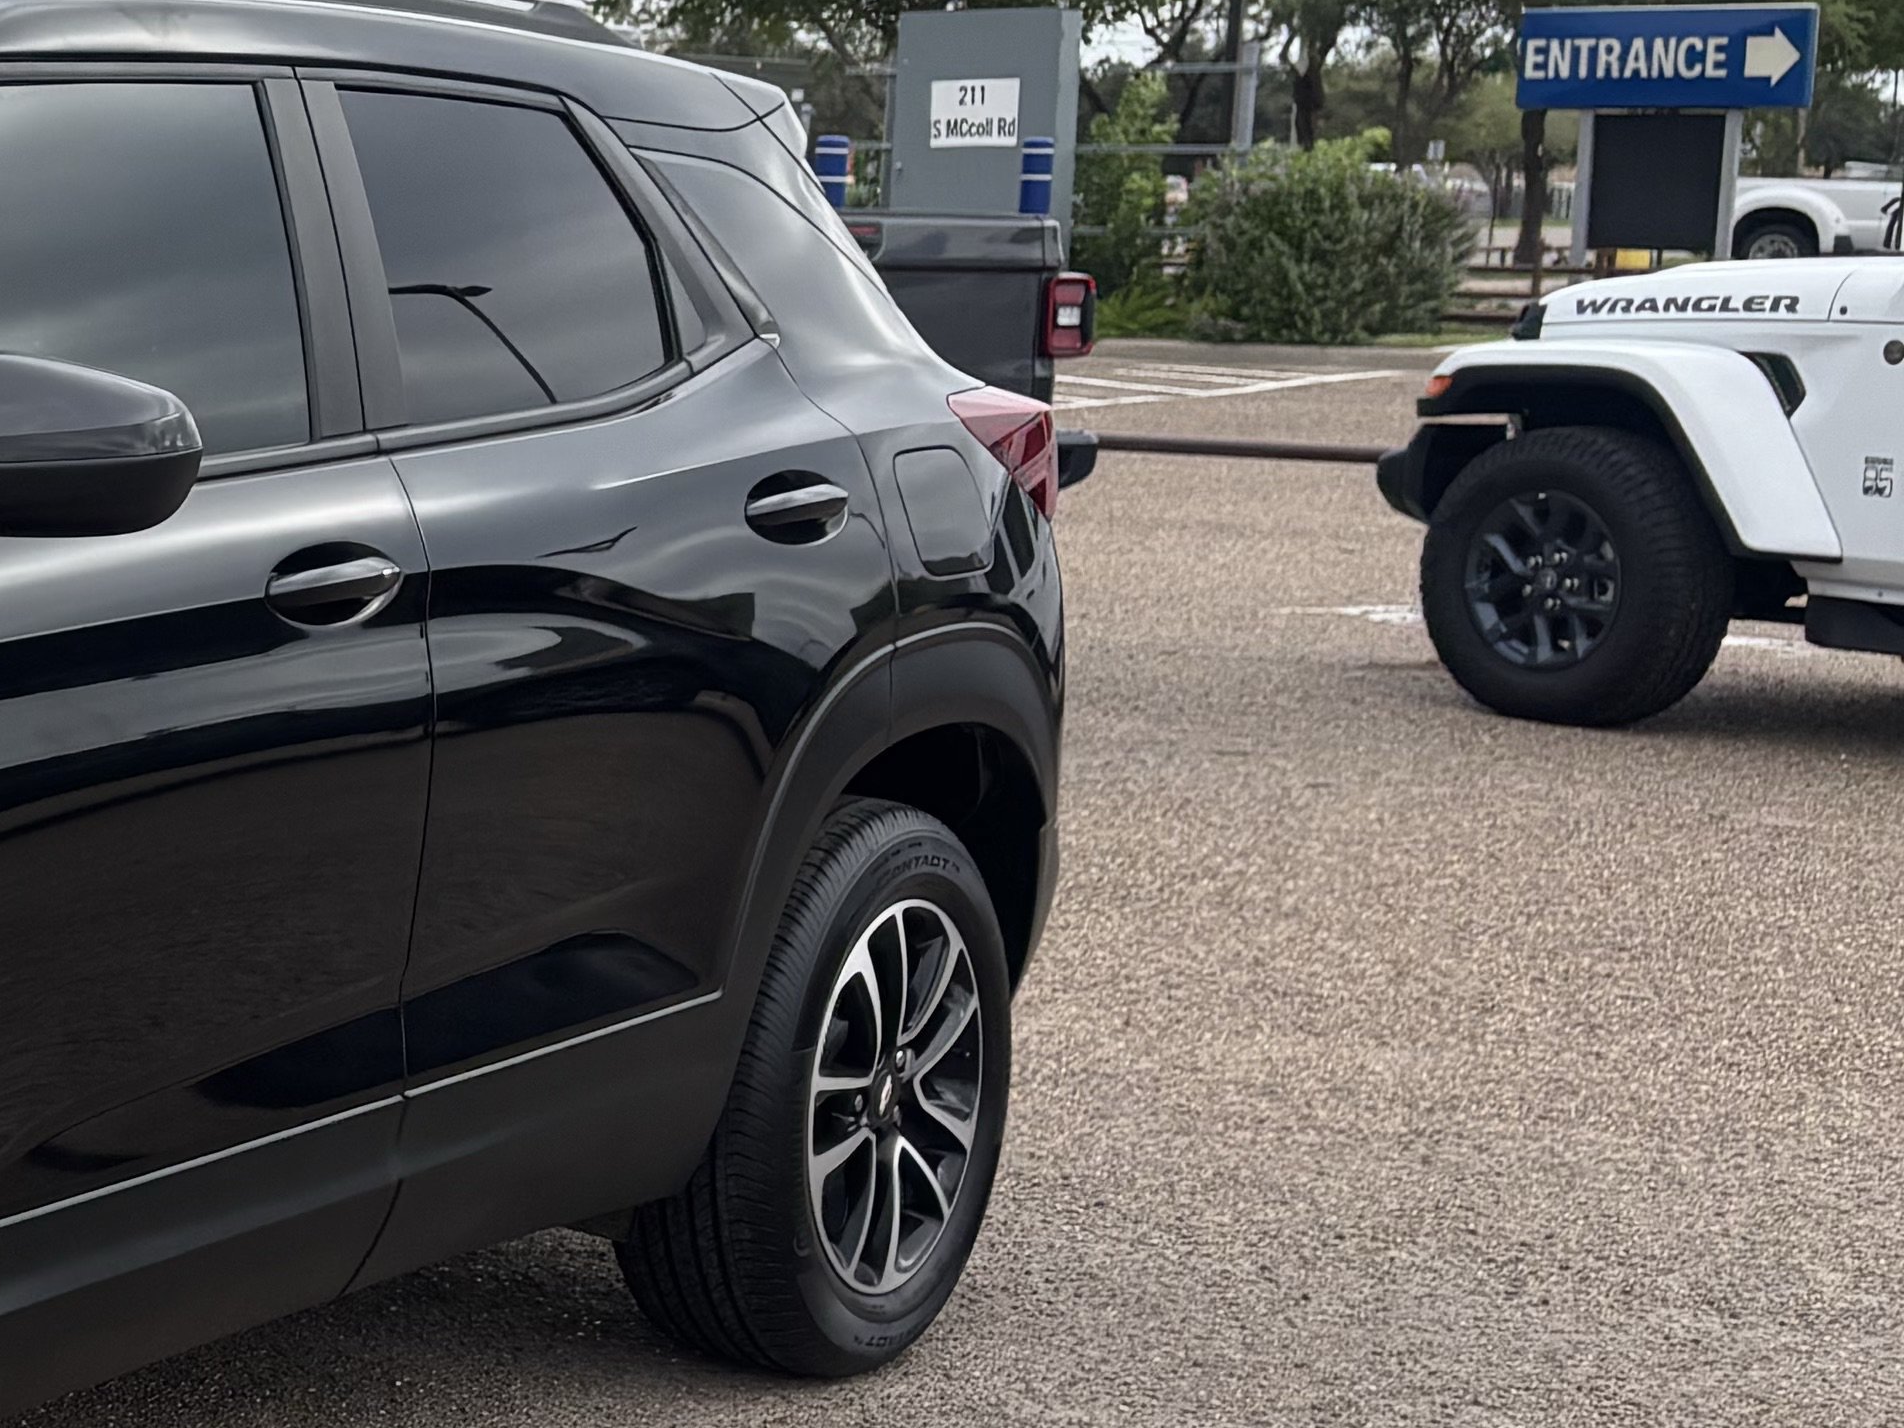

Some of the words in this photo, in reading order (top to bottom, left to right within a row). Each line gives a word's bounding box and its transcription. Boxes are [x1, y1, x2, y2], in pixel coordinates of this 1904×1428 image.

[1524, 36, 1729, 80] ENTRANCE
[959, 85, 985, 106] 211
[933, 119, 941, 139] S
[998, 116, 1016, 138] Rd
[1576, 295, 1800, 315] WRANGLER
